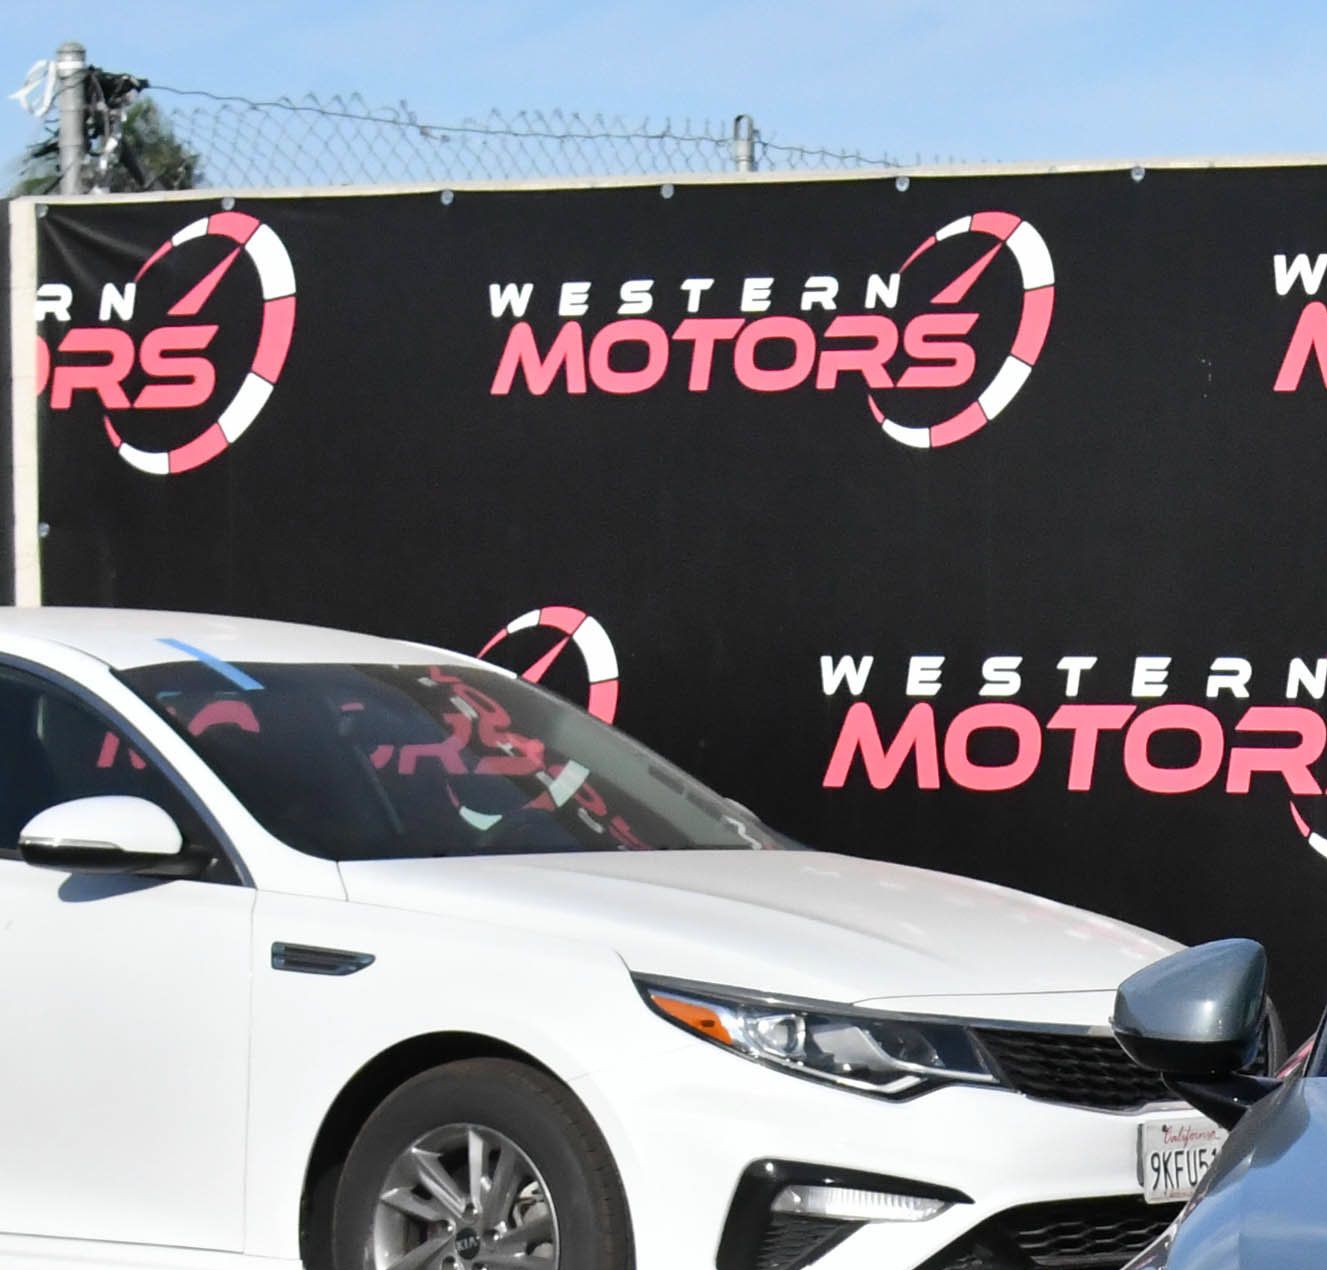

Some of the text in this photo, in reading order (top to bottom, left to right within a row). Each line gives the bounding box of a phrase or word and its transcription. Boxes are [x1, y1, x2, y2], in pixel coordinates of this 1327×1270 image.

[489, 272, 901, 319] WESTERN
[36, 324, 220, 410] RS
[490, 312, 980, 396] MOTORS
[1150, 1148, 1217, 1192] 9KFU5
